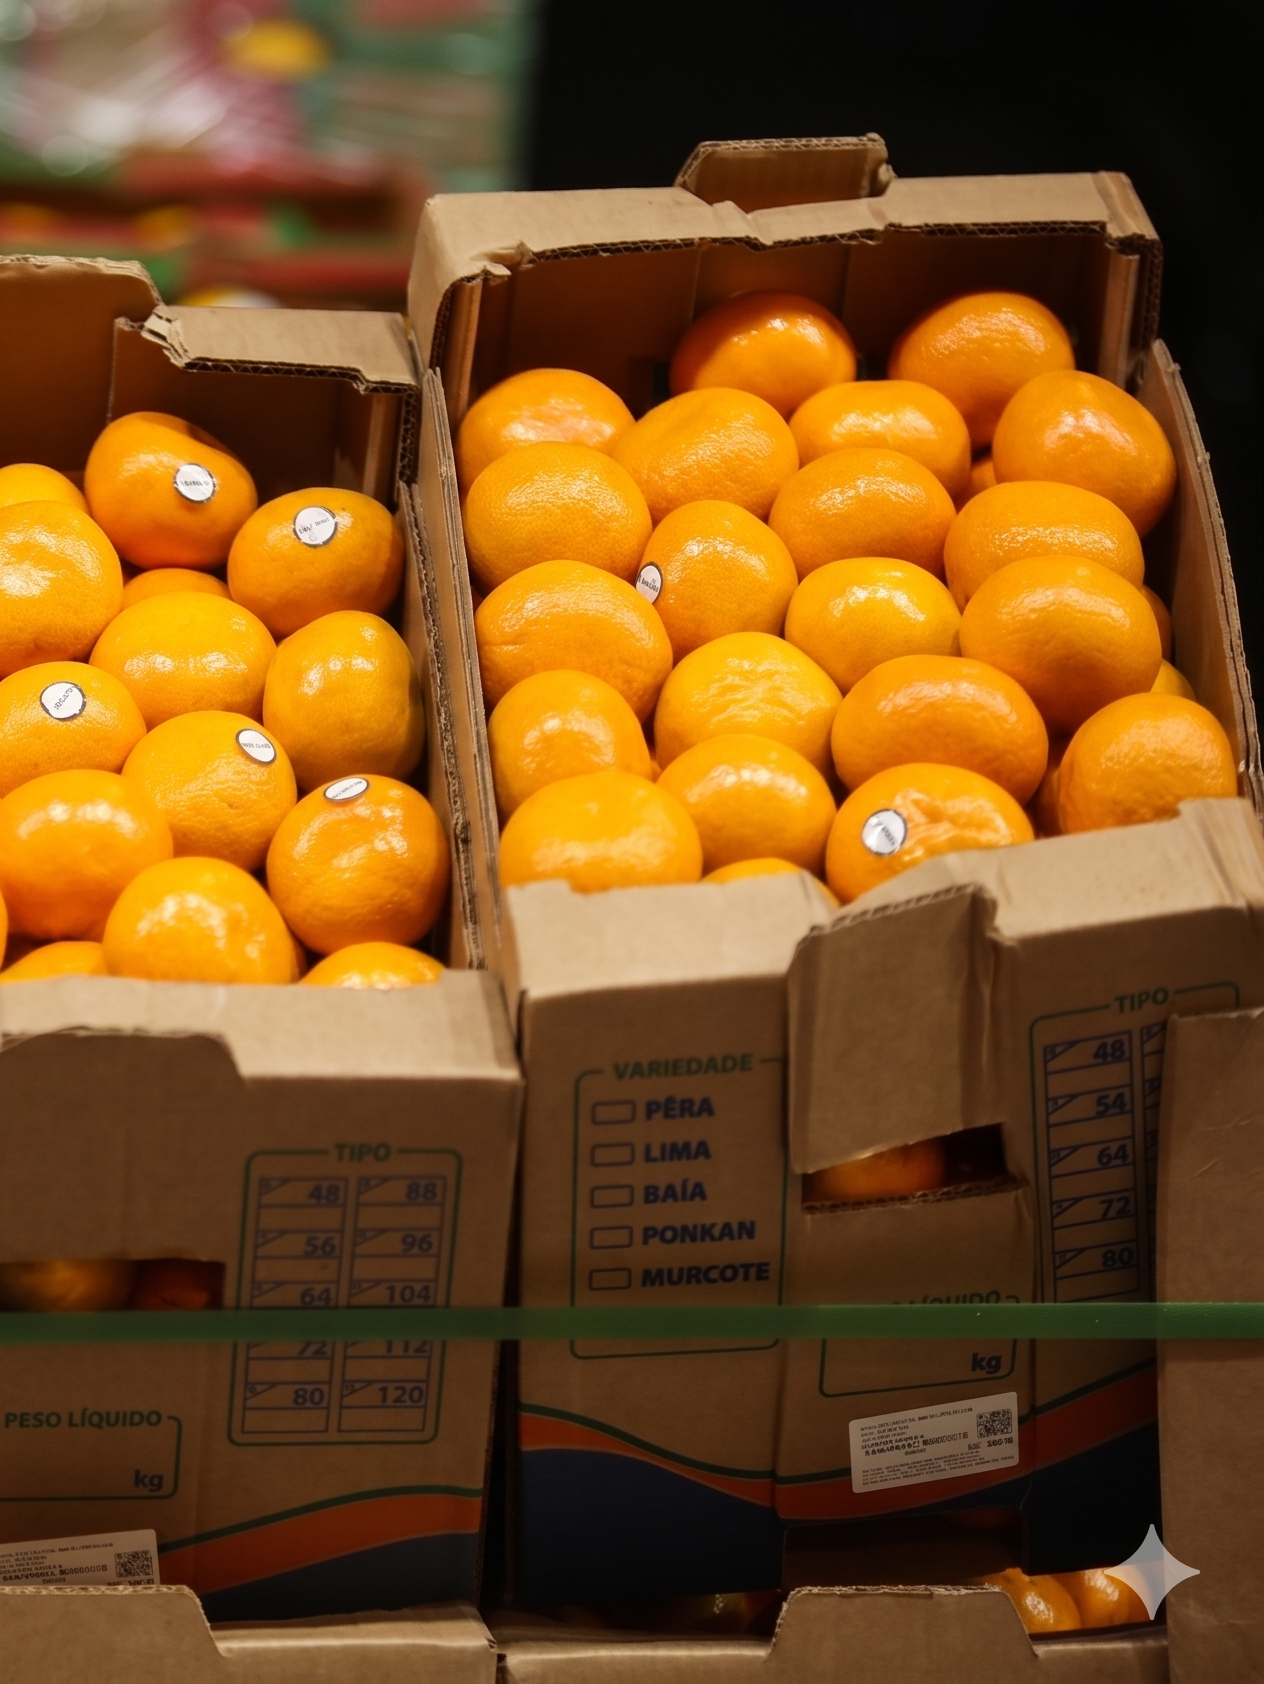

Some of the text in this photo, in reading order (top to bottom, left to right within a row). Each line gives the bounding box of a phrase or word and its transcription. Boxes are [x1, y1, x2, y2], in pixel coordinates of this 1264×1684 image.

[1114, 986, 1169, 1014] TIPO
[1093, 1038, 1126, 1064] 48
[613, 1053, 755, 1081] VARIEDADE
[644, 1095, 715, 1121] PÊRA
[1095, 1091, 1128, 1117] 54
[334, 1143, 391, 1163] TIPO
[643, 1140, 712, 1164] LIMA
[1096, 1143, 1130, 1167] 64
[308, 1183, 340, 1205] 48
[406, 1181, 438, 1202] 88
[643, 1178, 708, 1205] BAÍA
[1099, 1196, 1132, 1219] 72
[401, 1233, 434, 1254] 96
[641, 1219, 756, 1246] PONKAN
[304, 1235, 336, 1257] 56
[1102, 1247, 1134, 1270] 80
[641, 1261, 771, 1288] MURCOTE
[299, 1287, 332, 1307] 64
[386, 1284, 432, 1305] 104
[971, 1352, 1002, 1375] kg
[292, 1387, 325, 1407] 80
[378, 1385, 424, 1405] 120
[4, 1407, 163, 1430] PESO LÍQUIDO
[133, 1469, 165, 1493] kg
